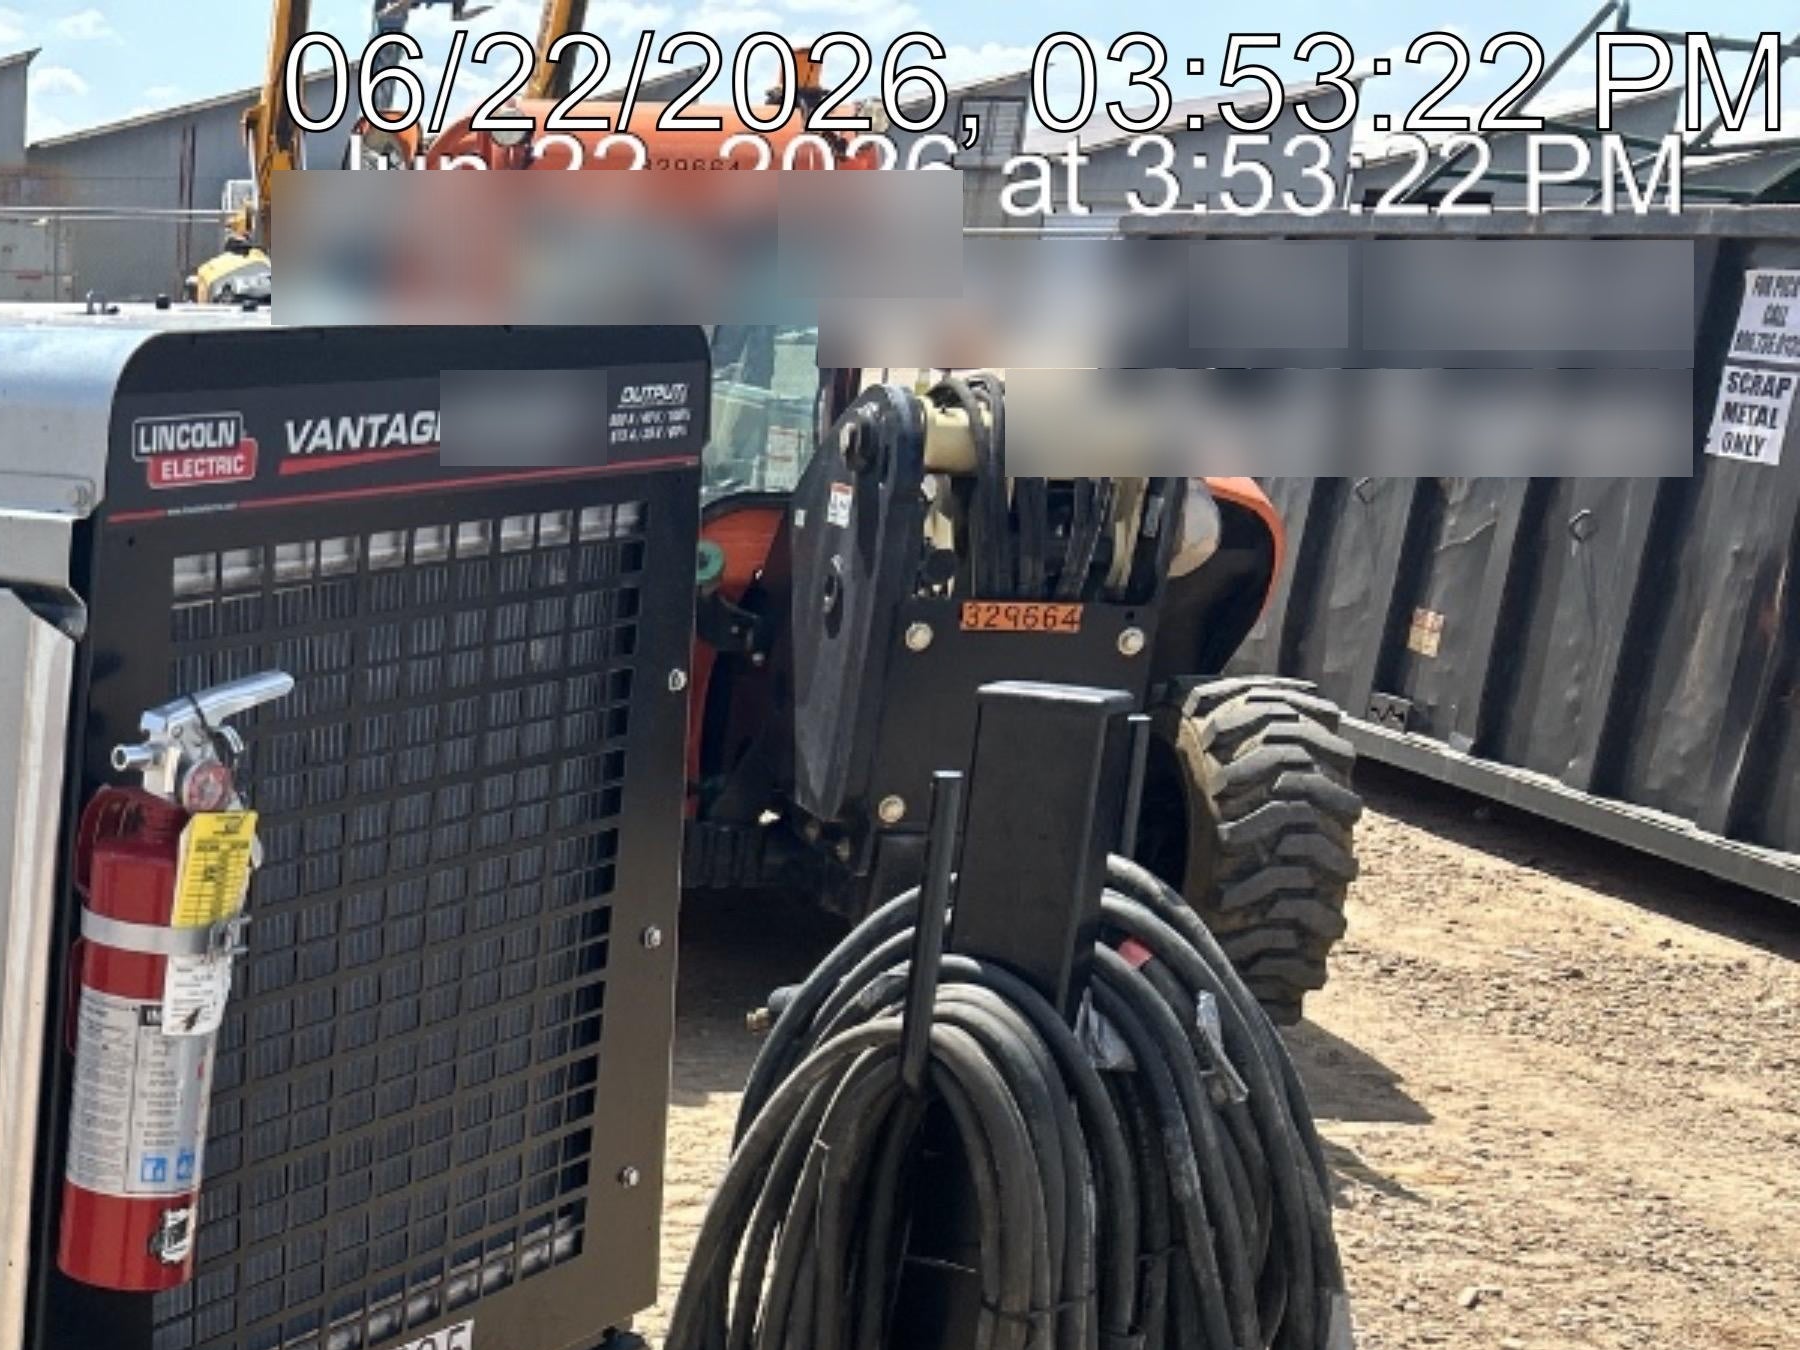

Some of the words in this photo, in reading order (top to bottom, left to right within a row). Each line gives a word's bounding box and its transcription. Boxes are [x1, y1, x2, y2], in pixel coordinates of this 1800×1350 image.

[1727, 371, 1792, 398] SCRAP
[1721, 401, 1779, 429] METAL
[140, 419, 237, 454] LINCOLN
[1721, 431, 1767, 457] ONLY
[160, 454, 246, 481] ELECTRIC
[963, 602, 1081, 631] 329664
